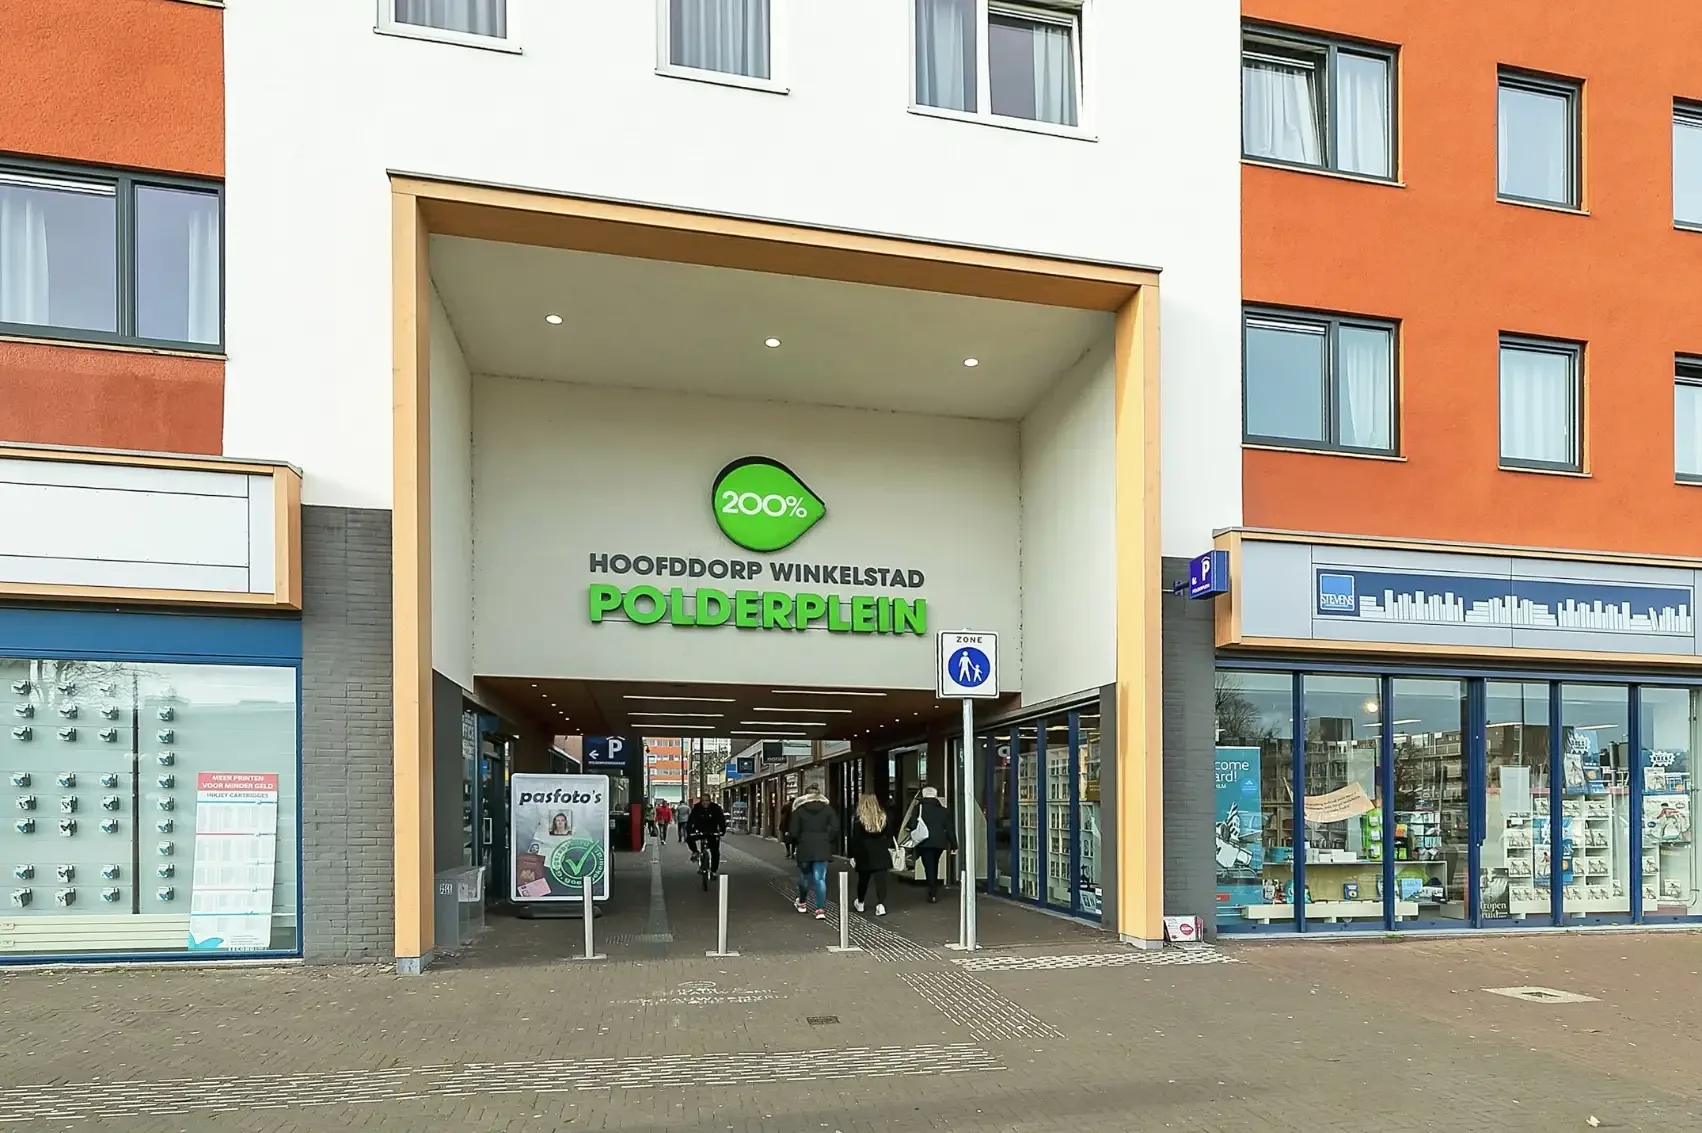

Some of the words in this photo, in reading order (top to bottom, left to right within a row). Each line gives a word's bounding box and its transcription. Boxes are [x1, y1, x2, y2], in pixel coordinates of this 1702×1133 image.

[721, 490, 808, 518] 200%
[589, 553, 762, 580] HOOFDDORP
[770, 562, 925, 588] WINKELSTAD
[1202, 560, 1210, 581] P
[589, 583, 928, 636] POLDERPLEIN
[1320, 593, 1354, 606] STEVENS
[608, 739, 623, 759] P
[1215, 761, 1250, 771] come
[1215, 770, 1237, 782] ard!
[518, 788, 602, 805] pasfoto's
